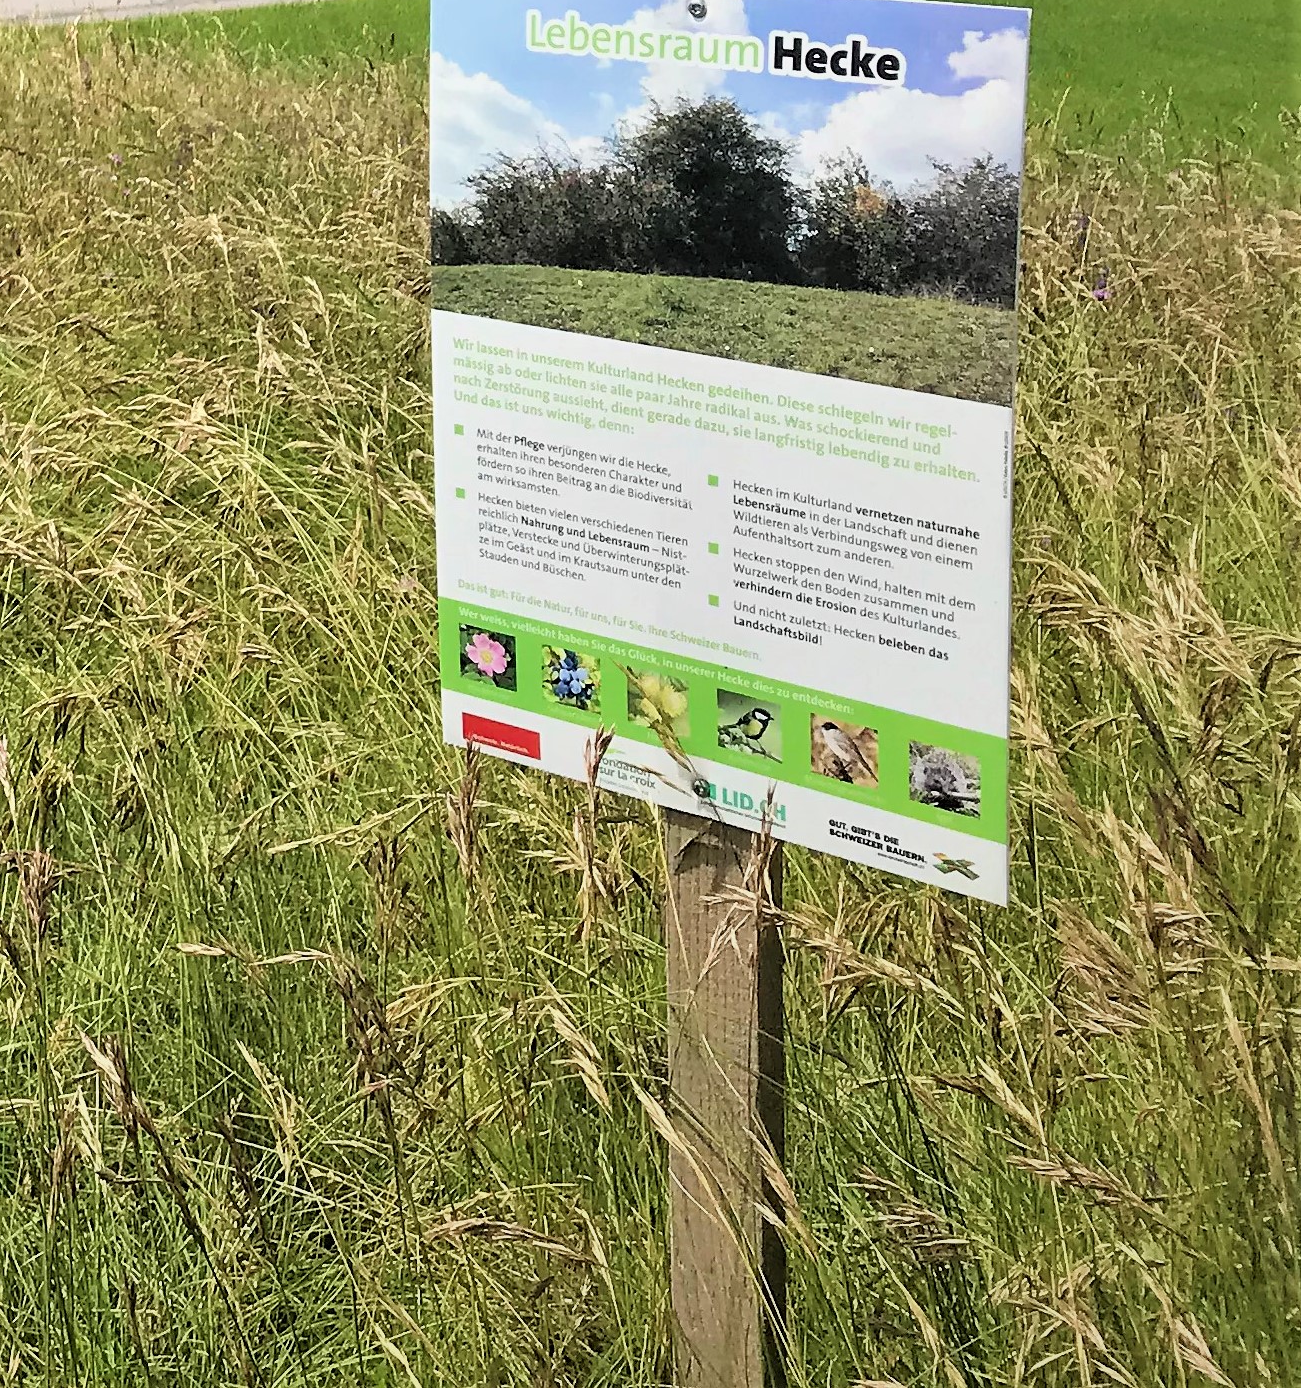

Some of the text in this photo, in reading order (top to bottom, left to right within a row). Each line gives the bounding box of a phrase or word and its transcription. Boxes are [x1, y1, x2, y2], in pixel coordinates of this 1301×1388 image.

[530, 14, 901, 81] Lebensraum Hecke
[452, 337, 956, 439] Wir lassen in unserem Kulturland Hecken gedeihen. Diese schlegeln wir regel-
[453, 357, 940, 455] mässig ab oder lichten sie alle paar Jahre radikal aus. Was schockierend und
[453, 390, 634, 434] Und das ist uns wichtig, denn:
[453, 374, 980, 483] nach Zerstörung aussieht, dient gerade dazu, sie langfristig lebendig zu erhalten.
[475, 427, 671, 478] Mit der Pflege verjüngen wir die Hecke,
[476, 443, 682, 493] erhalten ihren besonderen Charakter und
[476, 455, 693, 511] fördern so ihren Beitrag an die Biodiversität
[477, 471, 560, 497] am wirksamsten.
[477, 491, 688, 547] Hecken bieten vielen verschiedenen Tieren
[477, 506, 519, 524] reichlich
[520, 514, 565, 537] Nahrung
[565, 526, 586, 539] und
[587, 529, 650, 553] Lebensraum
[660, 545, 687, 563] Nist-
[732, 478, 980, 540] Hecken im Kulturland vernetzen naturnahe
[732, 493, 978, 556] Lebensräume in der Landschaft und dienen
[478, 547, 519, 566] Stauden
[520, 559, 541, 571] und
[478, 535, 682, 589] ze im Geäst und im Krautsaum unter den
[511, 526, 559, 547] Verstecke
[560, 535, 580, 552] und
[732, 508, 973, 571] Wildtieren als Verbindungsweg von einem
[732, 524, 894, 569] Aufenthaltsort zum anderen.
[732, 546, 976, 612] Hecken stoppen den Wind, halten mit dem
[732, 561, 955, 623] Wurzelwerk den Boden zusammen und
[732, 578, 961, 640] verhindern die Erosion des Kulturlandes.
[732, 614, 823, 646] Landschaftsbild!
[733, 599, 949, 661] Und nicht zuletzt: Hecken beleben das
[599, 764, 615, 777] sur
[600, 753, 651, 778] ondation
[829, 828, 883, 851] SCHWEIZER
[883, 835, 899, 846] DIE
